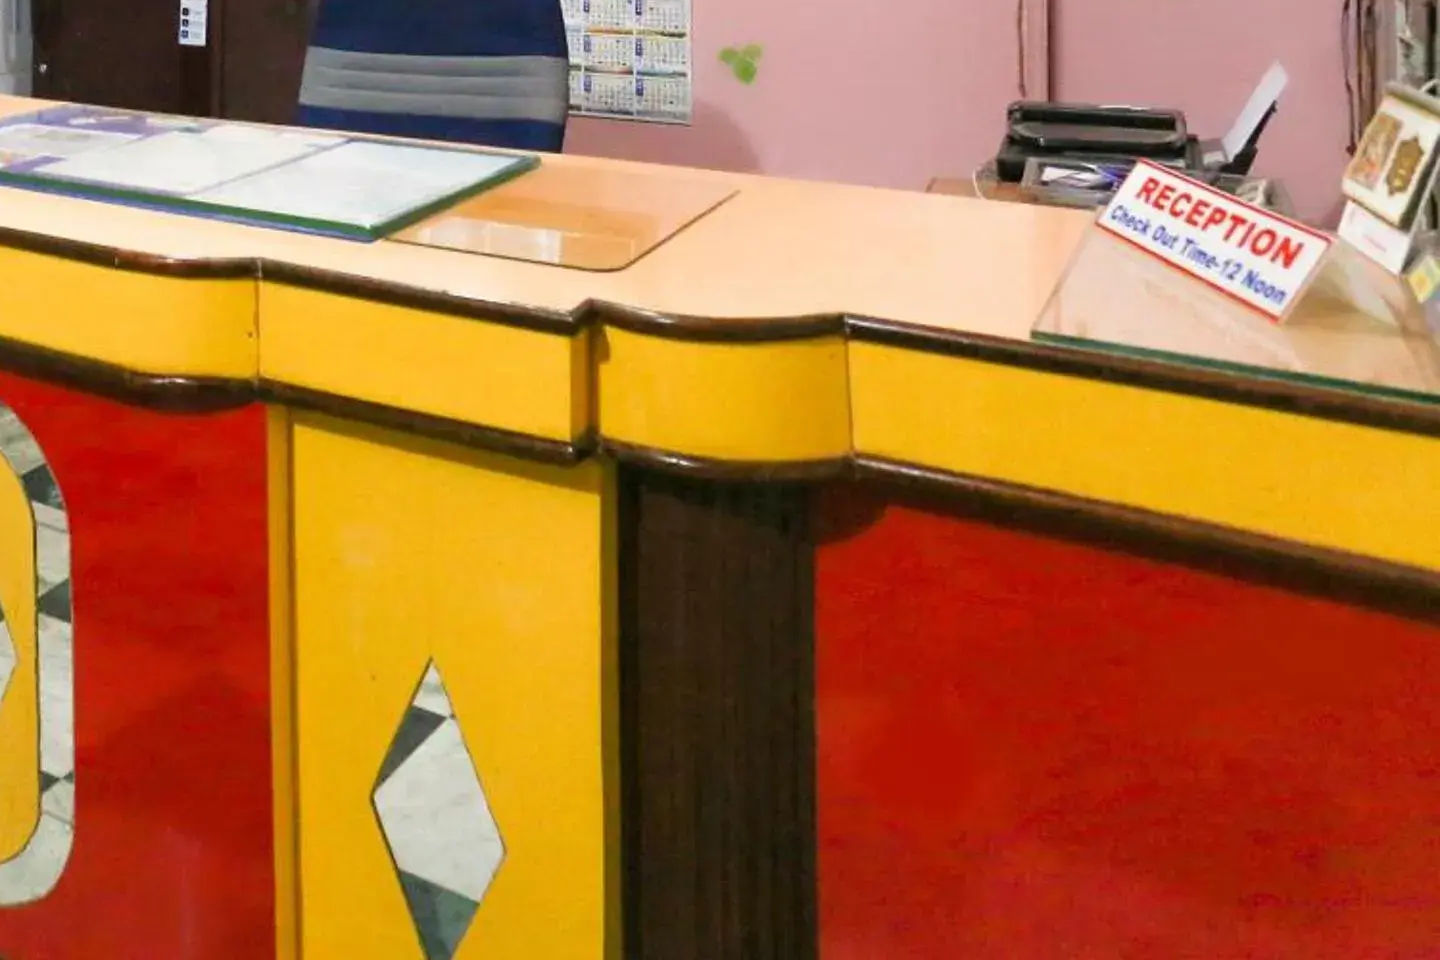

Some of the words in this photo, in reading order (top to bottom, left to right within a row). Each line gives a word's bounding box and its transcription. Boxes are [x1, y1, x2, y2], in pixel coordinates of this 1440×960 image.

[1110, 204, 1153, 234] Check
[1151, 226, 1180, 250] Out
[1241, 268, 1287, 305] Noon
[1135, 176, 1305, 270] RECEPTION
